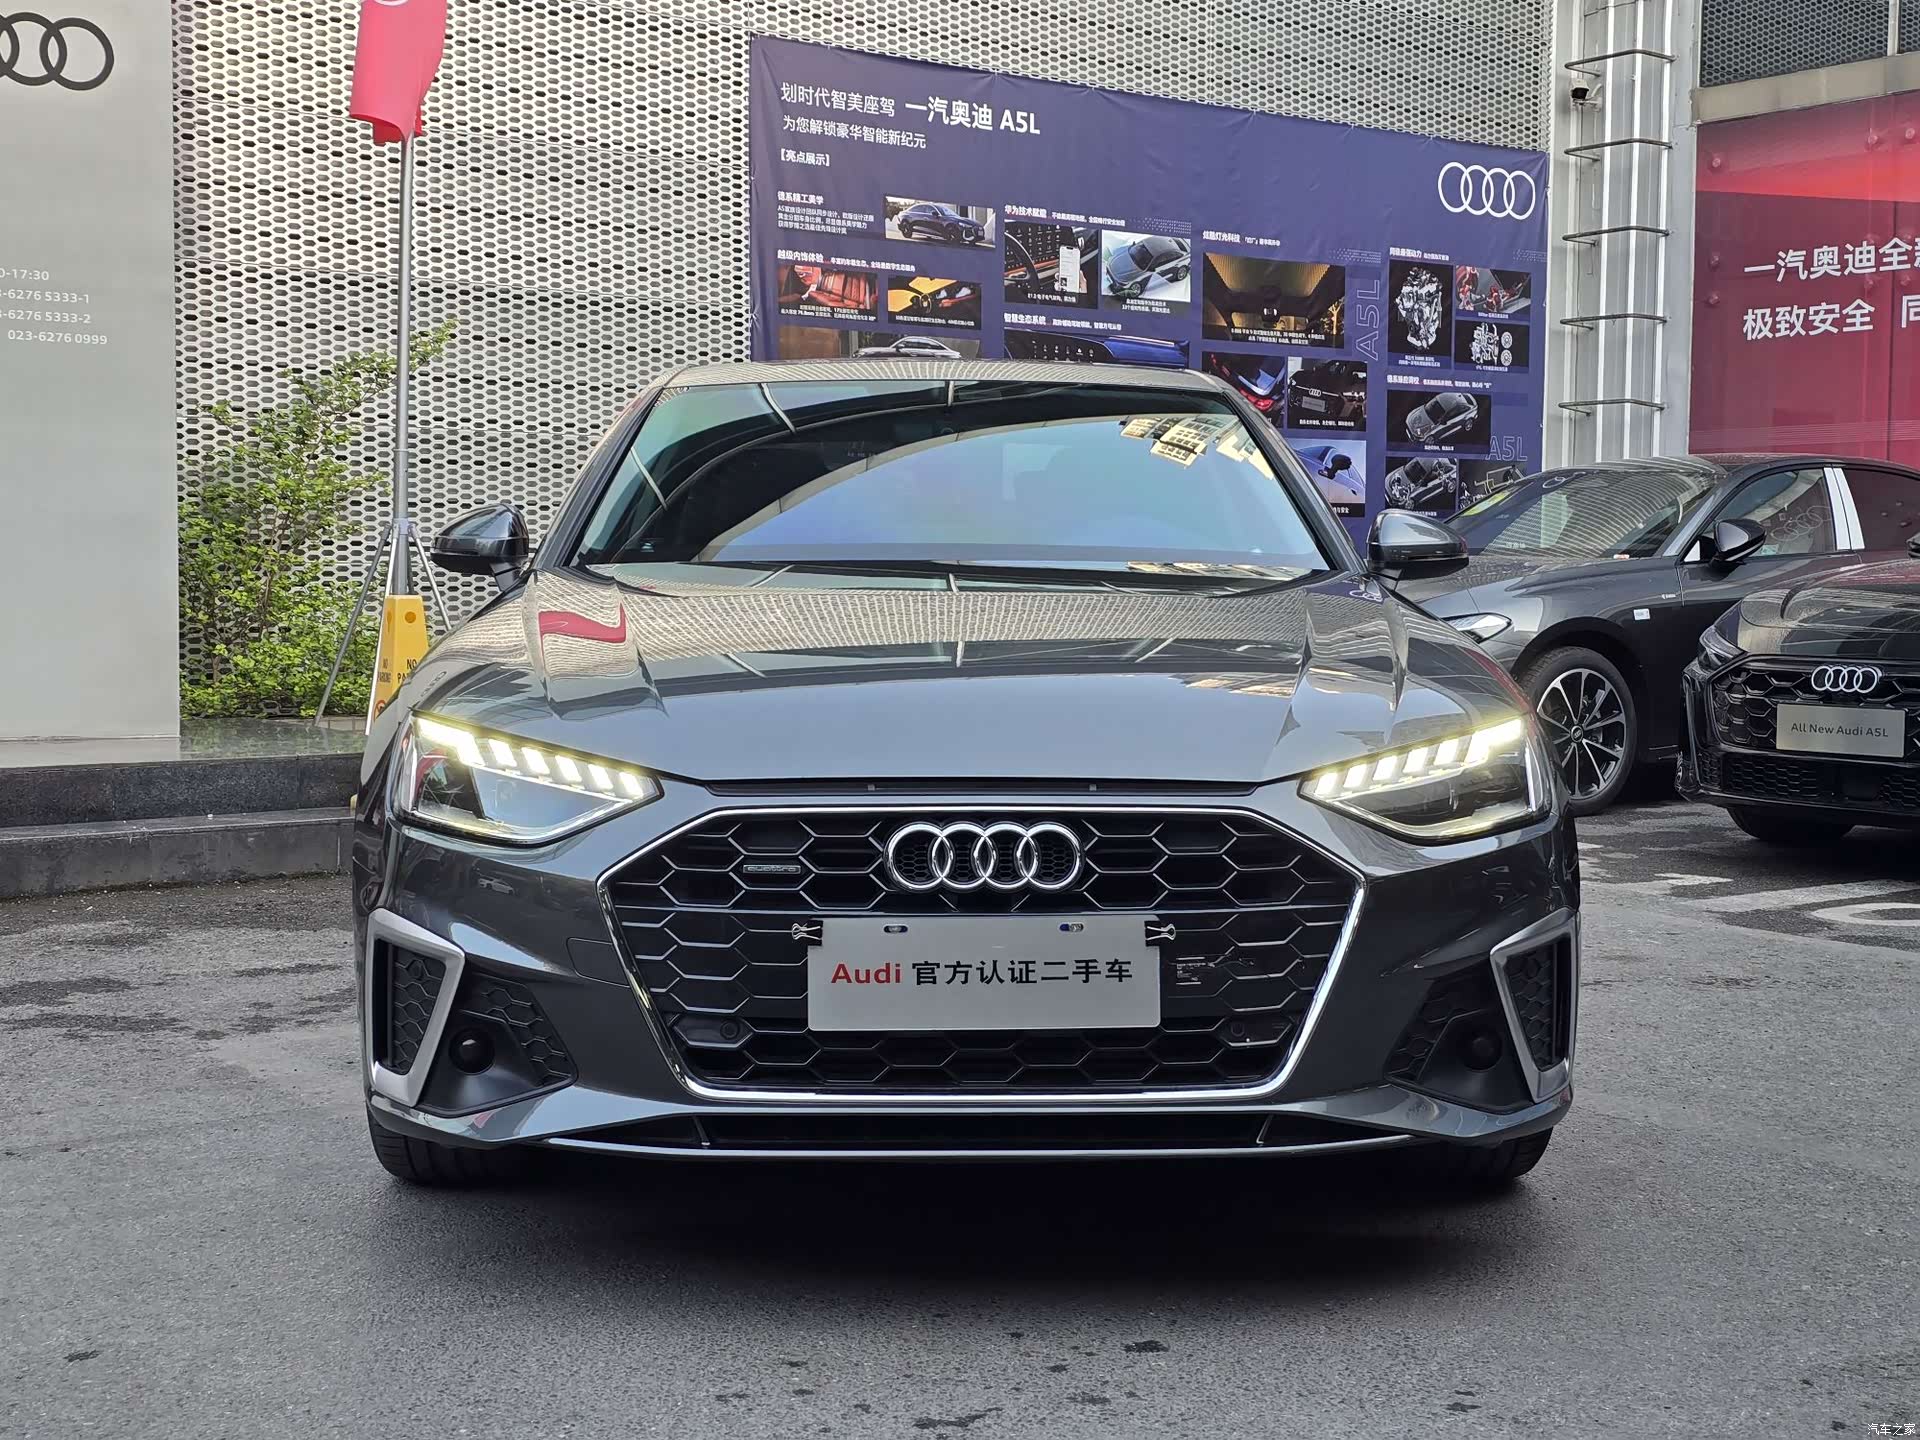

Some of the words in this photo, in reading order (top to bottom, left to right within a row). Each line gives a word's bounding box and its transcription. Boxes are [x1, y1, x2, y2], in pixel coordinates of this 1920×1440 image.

[780, 82, 895, 117] 划时代智美座驾
[905, 96, 993, 131] 一汽奥迪
[1000, 109, 1041, 135] A5L
[783, 114, 926, 149] 为您解锁豪华智能新纪元
[1743, 237, 1920, 283] 一汽奥迪全
[0, 289, 42, 301] -6276
[44, 291, 89, 303] 5333-1
[0, 309, 42, 321] -6276
[44, 311, 91, 324] 5333-2
[1356, 279, 1381, 361] A5L
[1743, 299, 1875, 341] 极致安全
[7, 329, 72, 343] 023-6276
[74, 333, 108, 345] 0999
[1486, 435, 1528, 461] A5L
[1791, 722, 1806, 733] All
[1809, 723, 1834, 734] New
[1836, 725, 1863, 736] Audi
[831, 962, 901, 984] Audi
[912, 958, 1133, 986] 官方认证二手车
